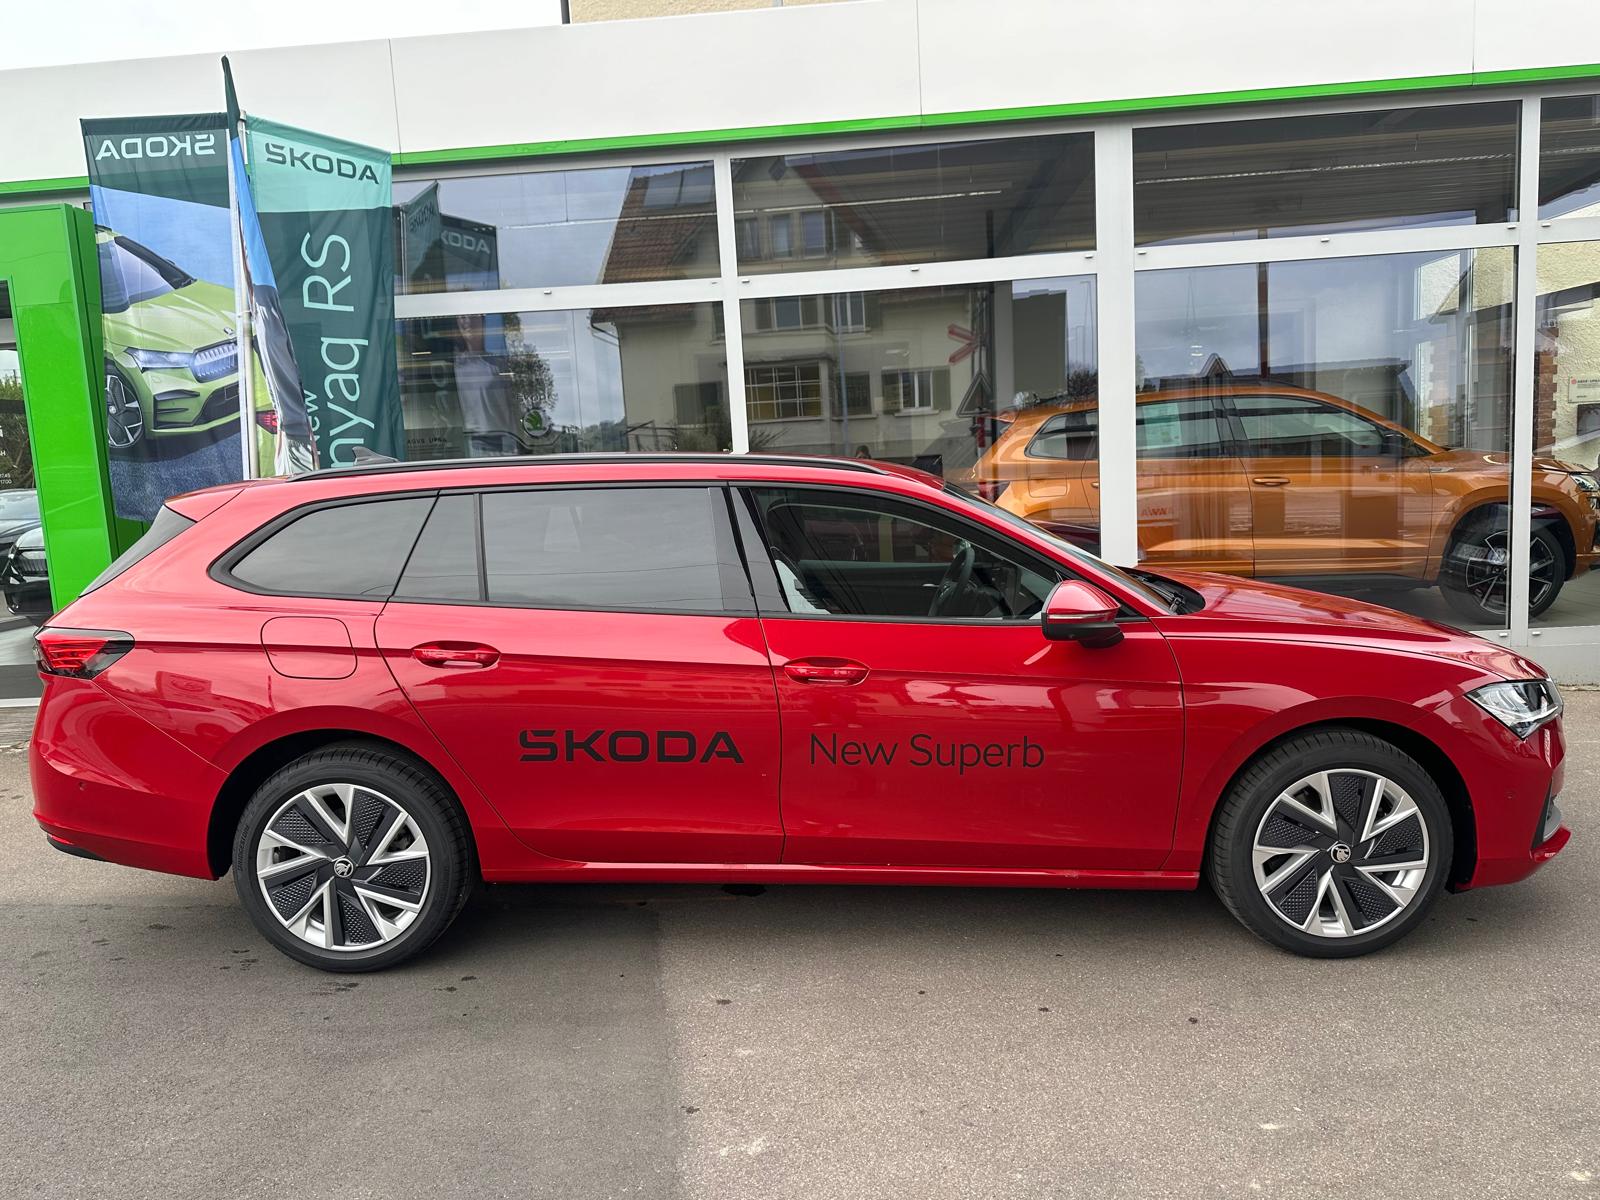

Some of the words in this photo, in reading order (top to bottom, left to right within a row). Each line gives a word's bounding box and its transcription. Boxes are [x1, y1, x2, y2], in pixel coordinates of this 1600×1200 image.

[264, 142, 379, 185] SKODA
[440, 230, 490, 254] KODA
[301, 231, 355, 312] RS
[320, 336, 375, 467] nyaq
[518, 729, 745, 764] SKODA
[810, 732, 898, 767] New
[909, 733, 1045, 776] Superb
